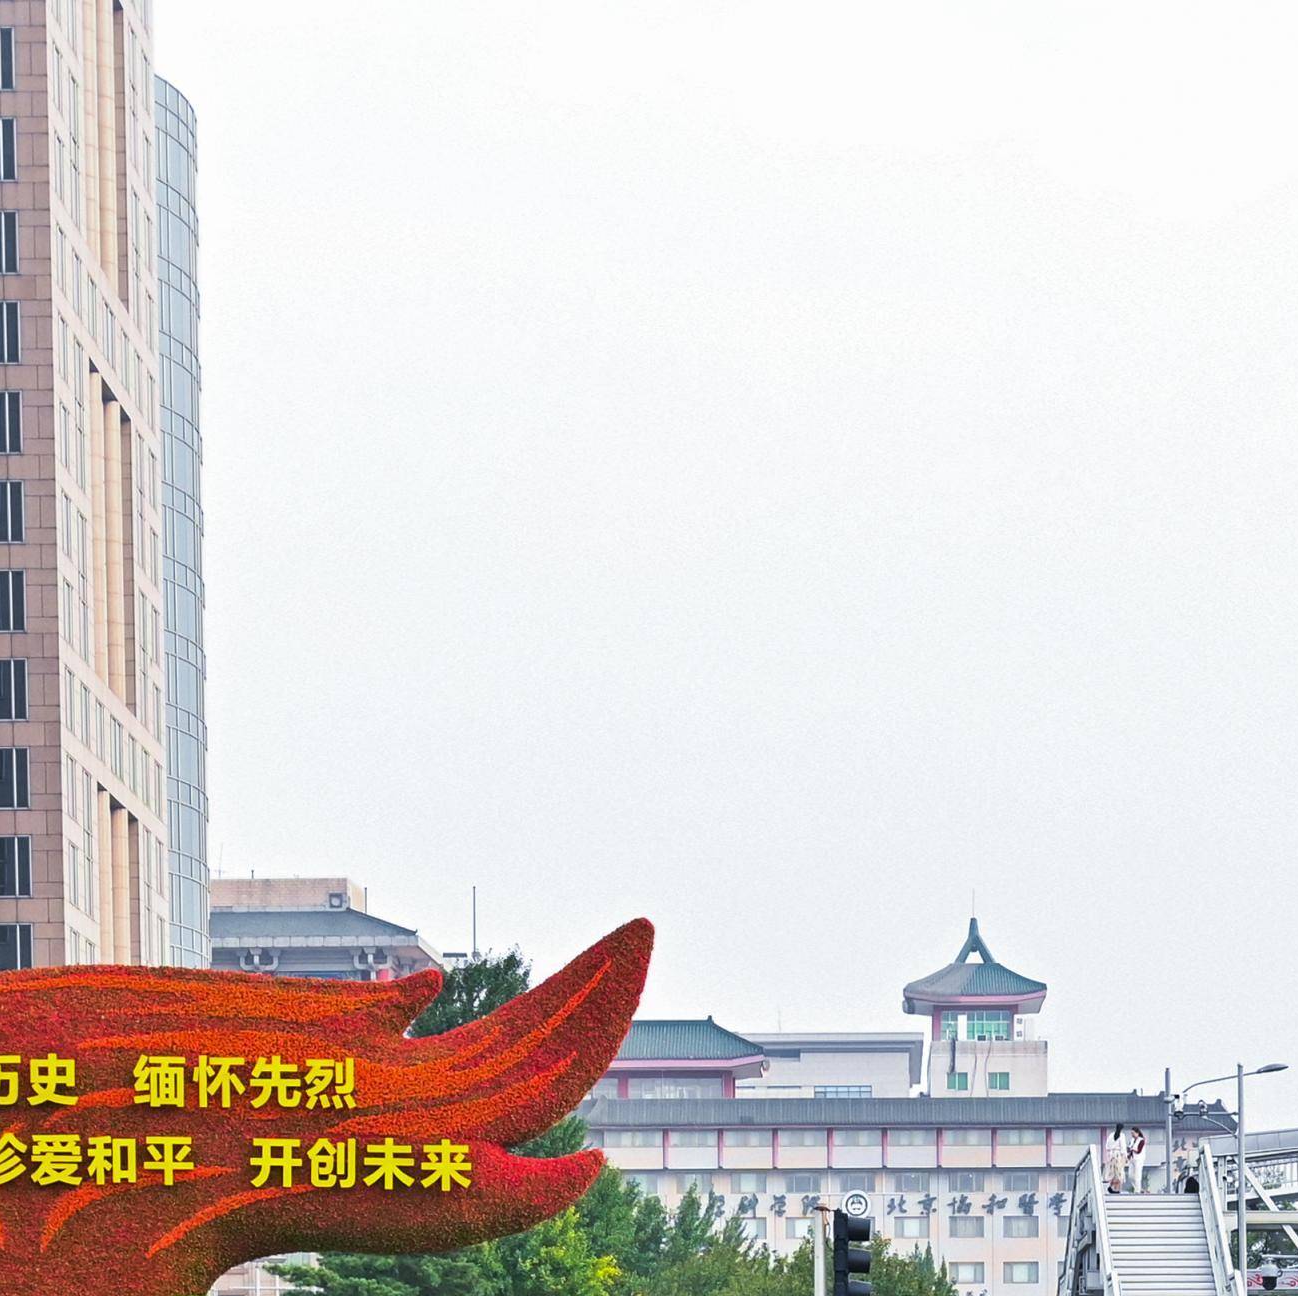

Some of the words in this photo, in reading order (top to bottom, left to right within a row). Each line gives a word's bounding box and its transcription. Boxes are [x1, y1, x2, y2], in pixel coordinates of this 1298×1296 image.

[133, 1054, 357, 1109] 缅怀先烈
[249, 1137, 473, 1193] 开创未来
